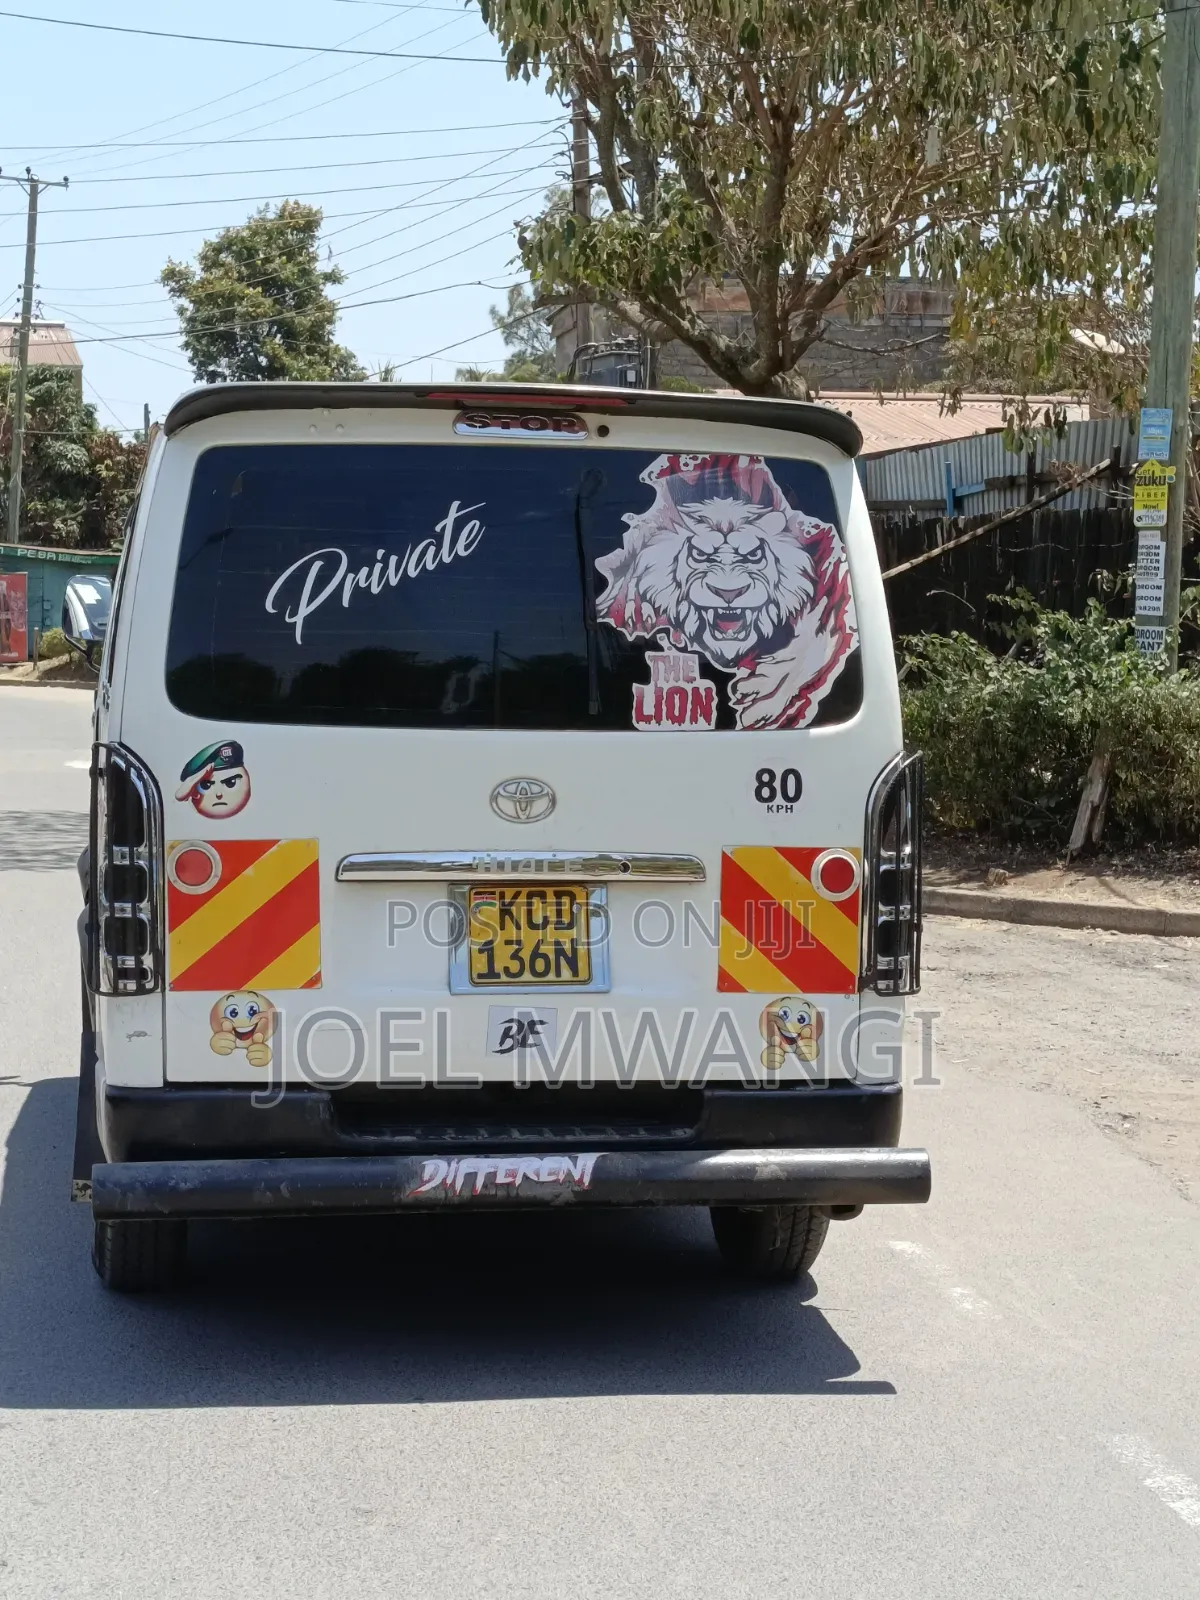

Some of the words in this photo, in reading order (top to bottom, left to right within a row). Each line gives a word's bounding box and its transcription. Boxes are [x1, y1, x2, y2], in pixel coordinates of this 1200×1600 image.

[464, 413, 578, 434] STOP
[1136, 468, 1151, 476] Get
[1135, 491, 1166, 499] FIBER
[17, 548, 56, 561] PESA
[265, 500, 486, 645] Private
[650, 655, 697, 684] THE
[634, 686, 715, 726] LION
[754, 767, 803, 804] 80
[766, 804, 794, 814] KPH
[477, 856, 584, 874] HIACE
[498, 889, 577, 931] KCD
[477, 938, 580, 980] 136N
[405, 1152, 611, 1197] DIFFERENT
